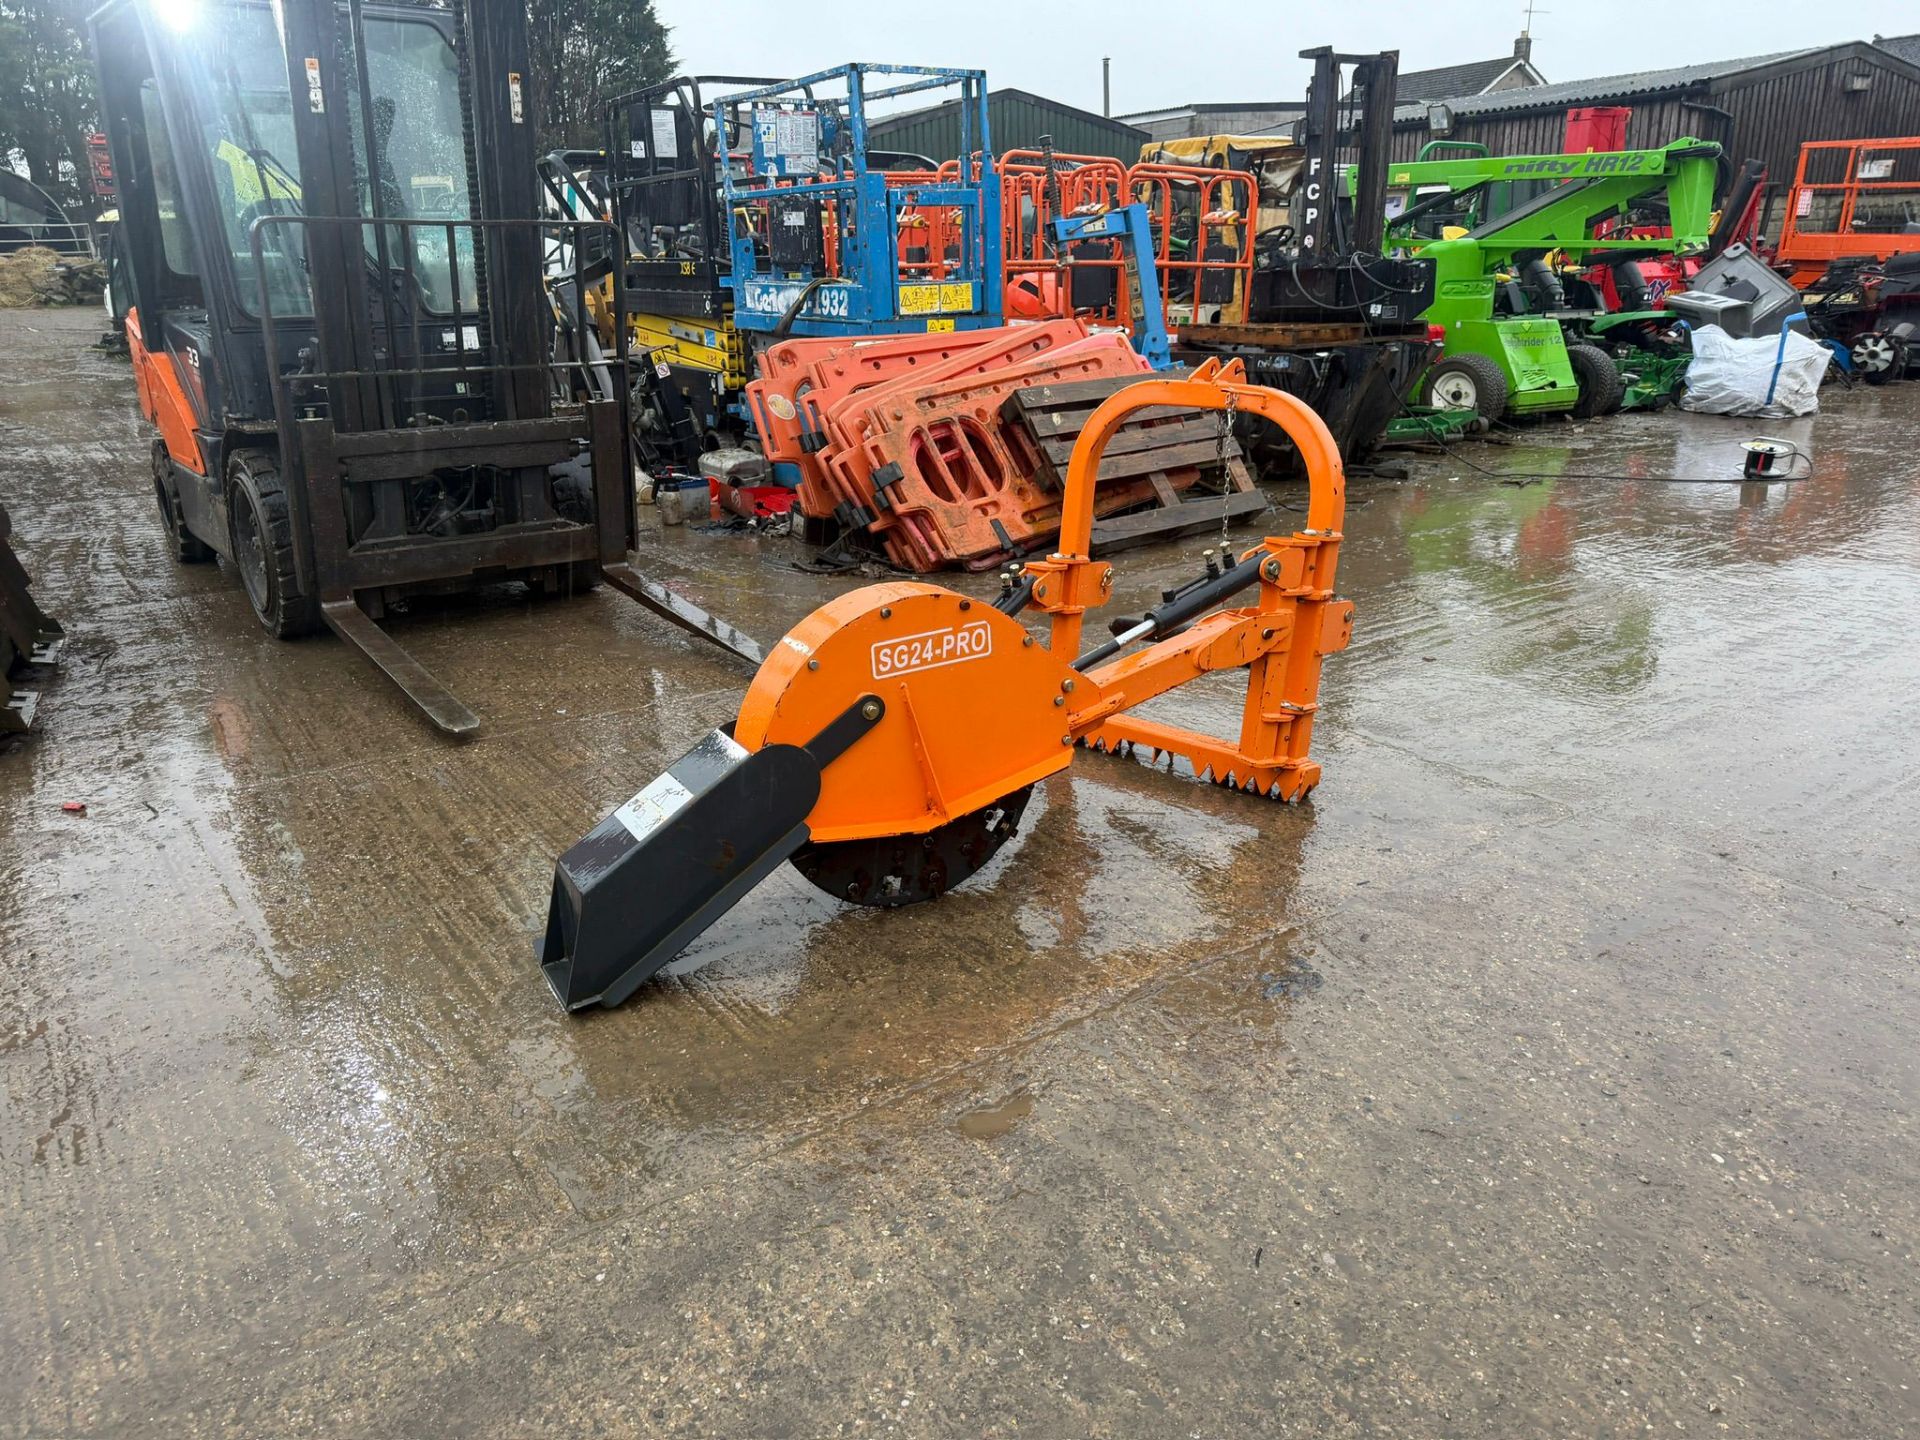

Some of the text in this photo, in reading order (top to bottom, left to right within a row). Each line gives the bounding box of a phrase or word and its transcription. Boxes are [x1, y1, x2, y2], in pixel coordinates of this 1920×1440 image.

[1504, 155, 1646, 174] nifty HR12
[1549, 335, 1562, 345] 12
[878, 628, 987, 673] SG24-PRO
